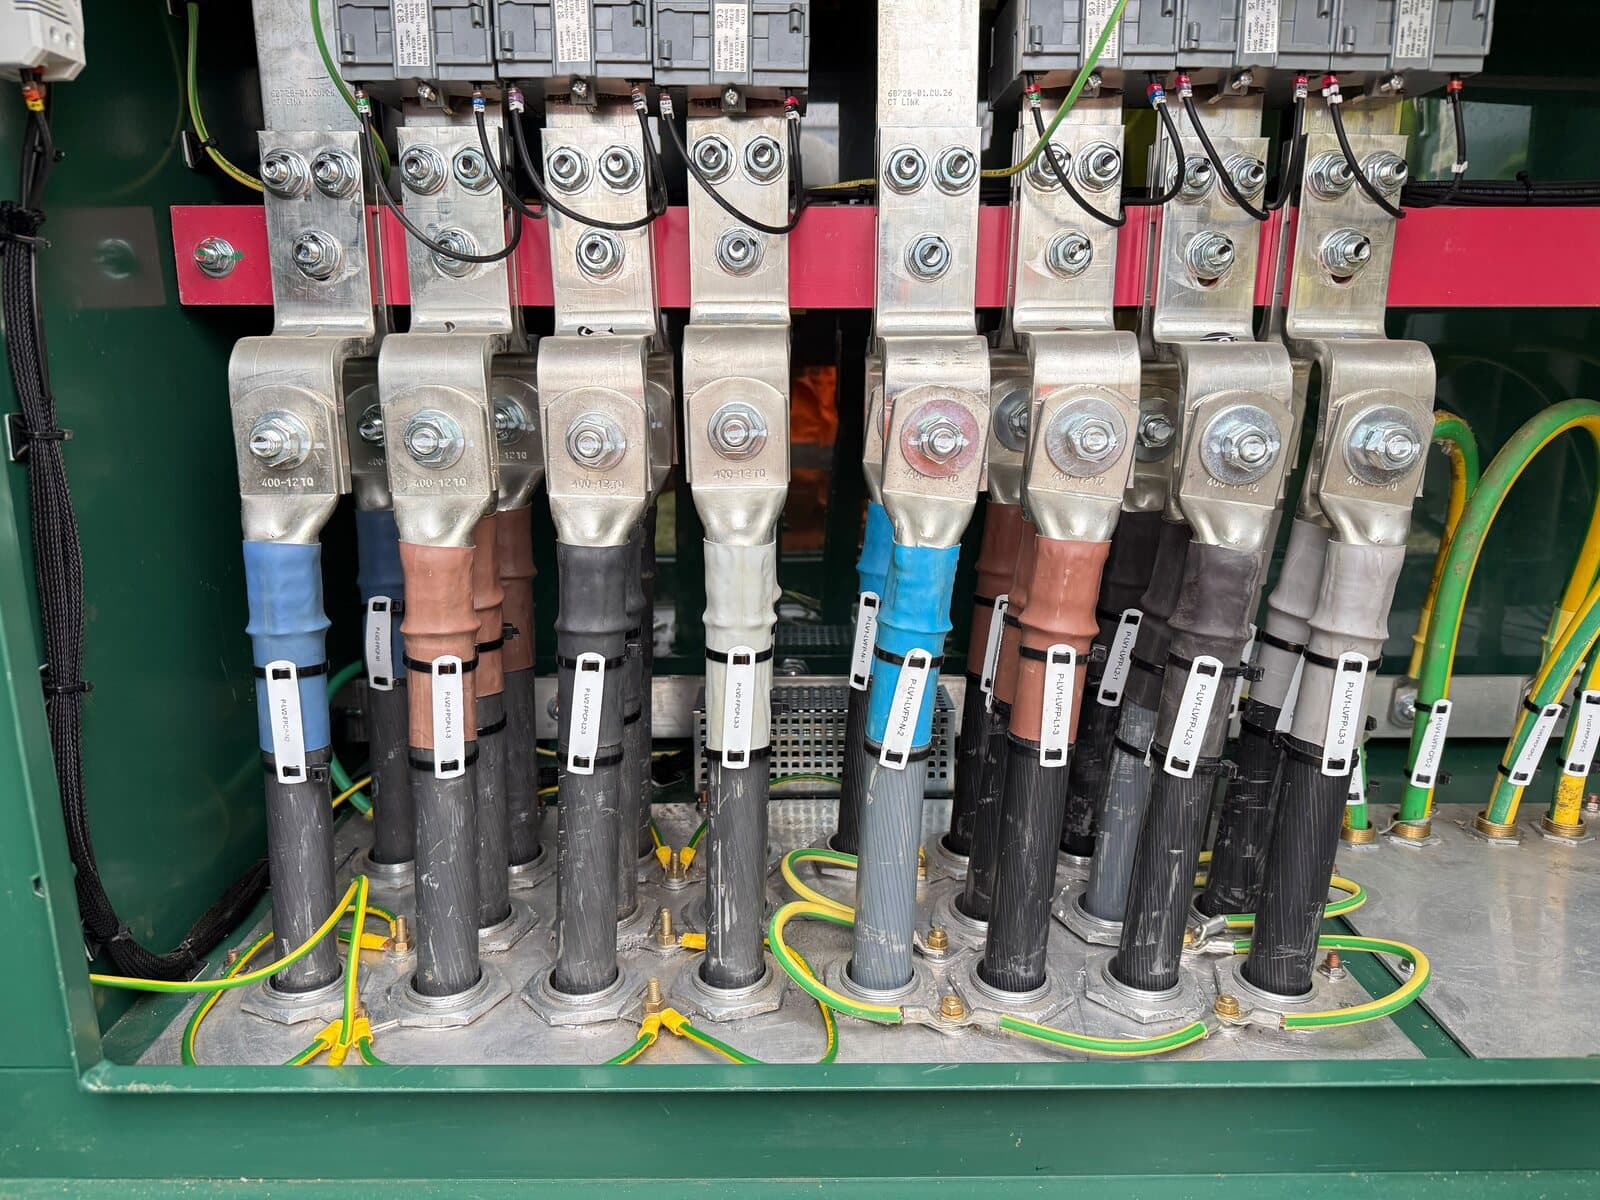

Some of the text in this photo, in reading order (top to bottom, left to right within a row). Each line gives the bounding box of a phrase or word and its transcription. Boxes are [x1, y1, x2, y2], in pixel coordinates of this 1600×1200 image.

[897, 678, 917, 737] P-LV1-LVFP-N-2
[1052, 673, 1065, 735] P-LV1-LVFP-L1-3
[1183, 684, 1207, 746] P-LV1-LVFP-L2-3
[1337, 681, 1354, 745] P-LV1-LVFP-L3-3
